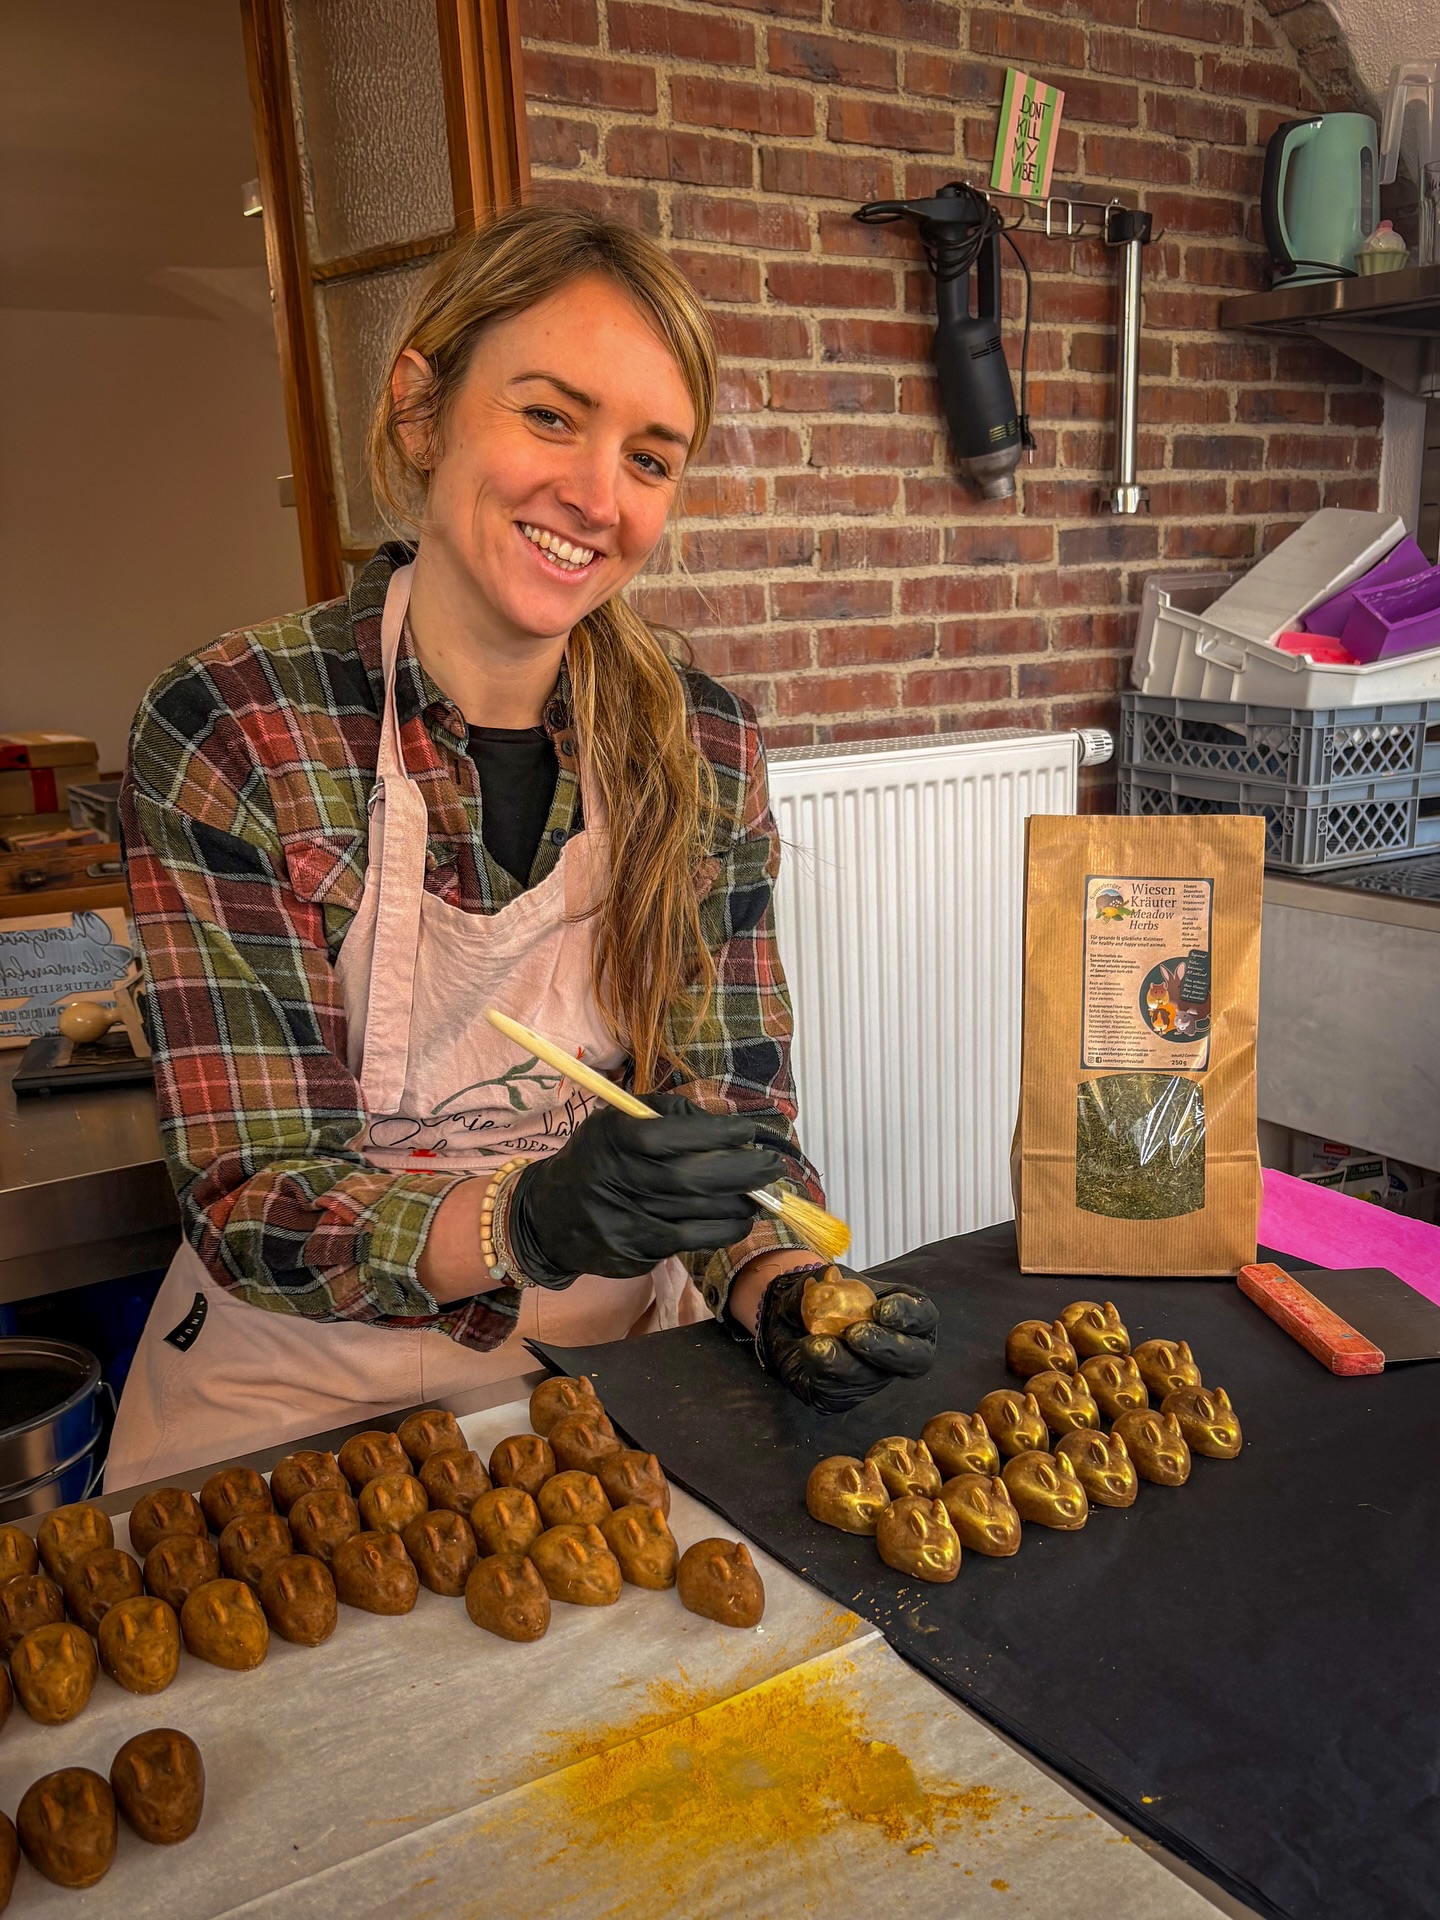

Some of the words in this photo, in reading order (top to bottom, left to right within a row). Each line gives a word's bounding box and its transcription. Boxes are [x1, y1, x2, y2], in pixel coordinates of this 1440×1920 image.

[1019, 94, 1051, 120] DONT
[1016, 115, 1041, 141] KILL
[1013, 137, 1038, 162] MY
[1011, 157, 1041, 194] VIBE!
[1131, 884, 1176, 896] Wiesen
[1130, 896, 1177, 908] Kräuter
[1130, 909, 1175, 920] Meadow
[1129, 920, 1159, 931] Herbs
